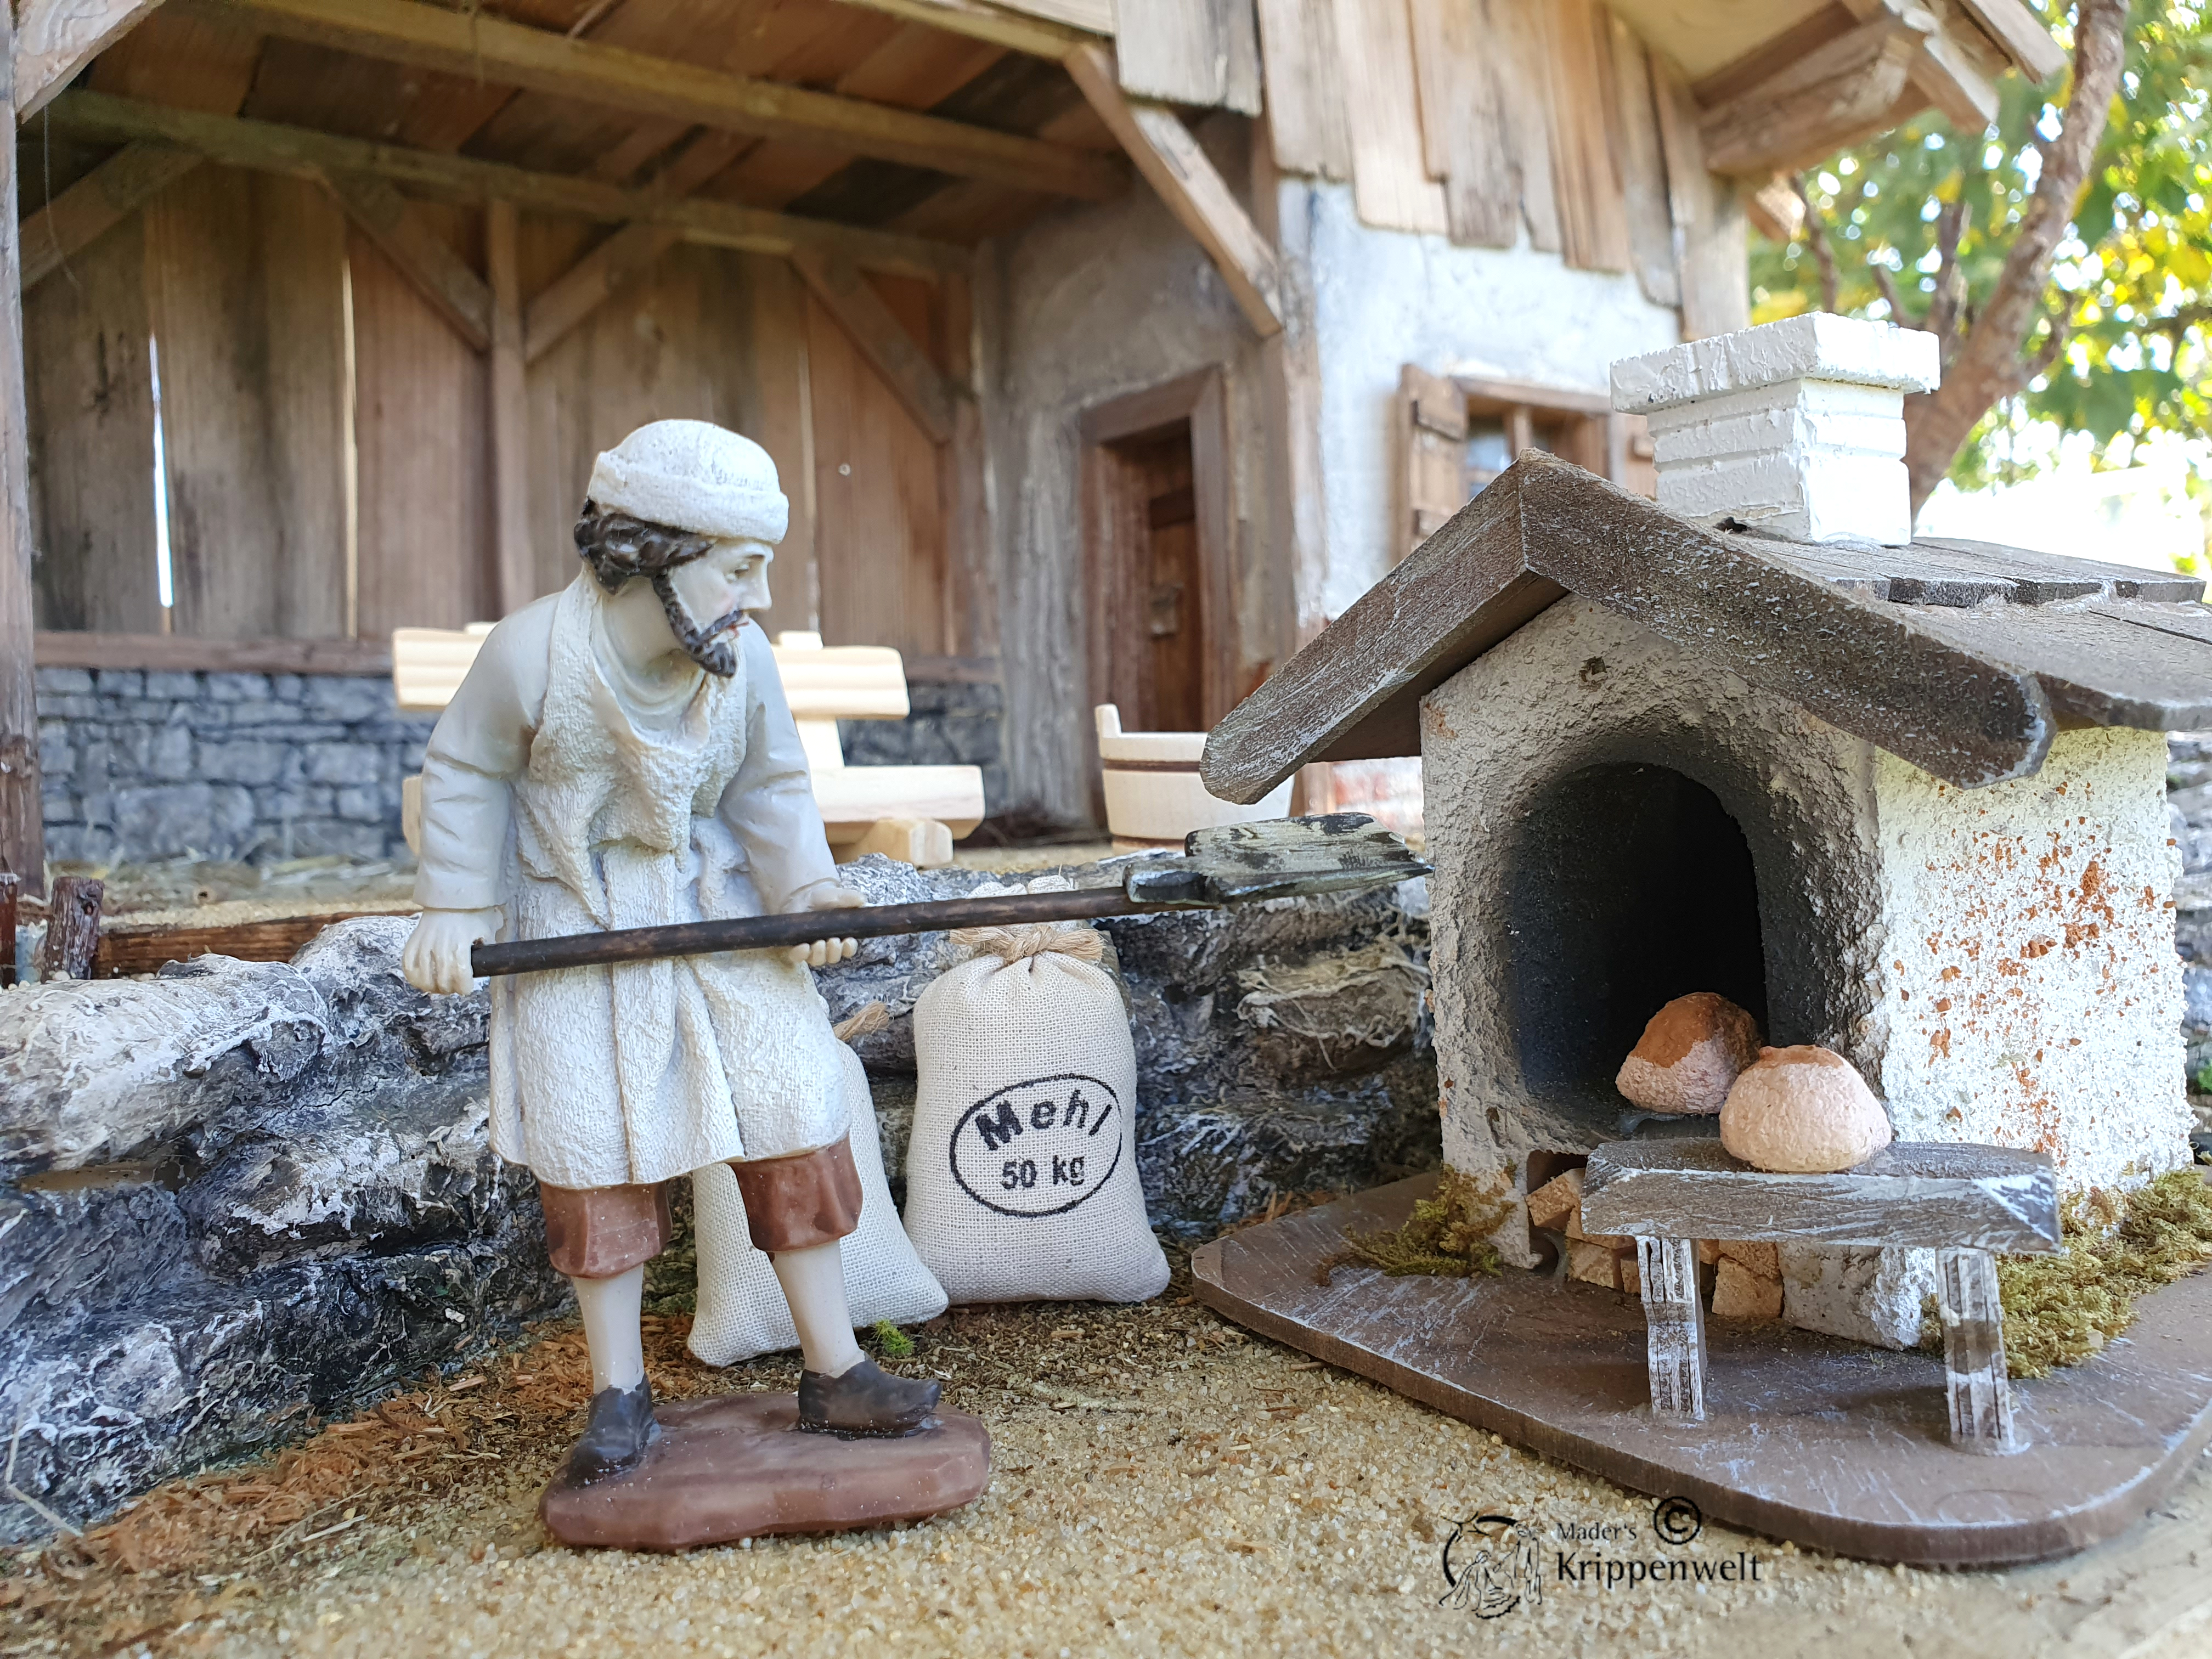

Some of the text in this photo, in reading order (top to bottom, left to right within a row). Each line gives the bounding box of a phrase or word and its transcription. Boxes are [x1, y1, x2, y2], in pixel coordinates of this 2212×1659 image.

[975, 1089, 1112, 1150] Mehl
[1002, 1155, 1085, 1189] 50 kg
